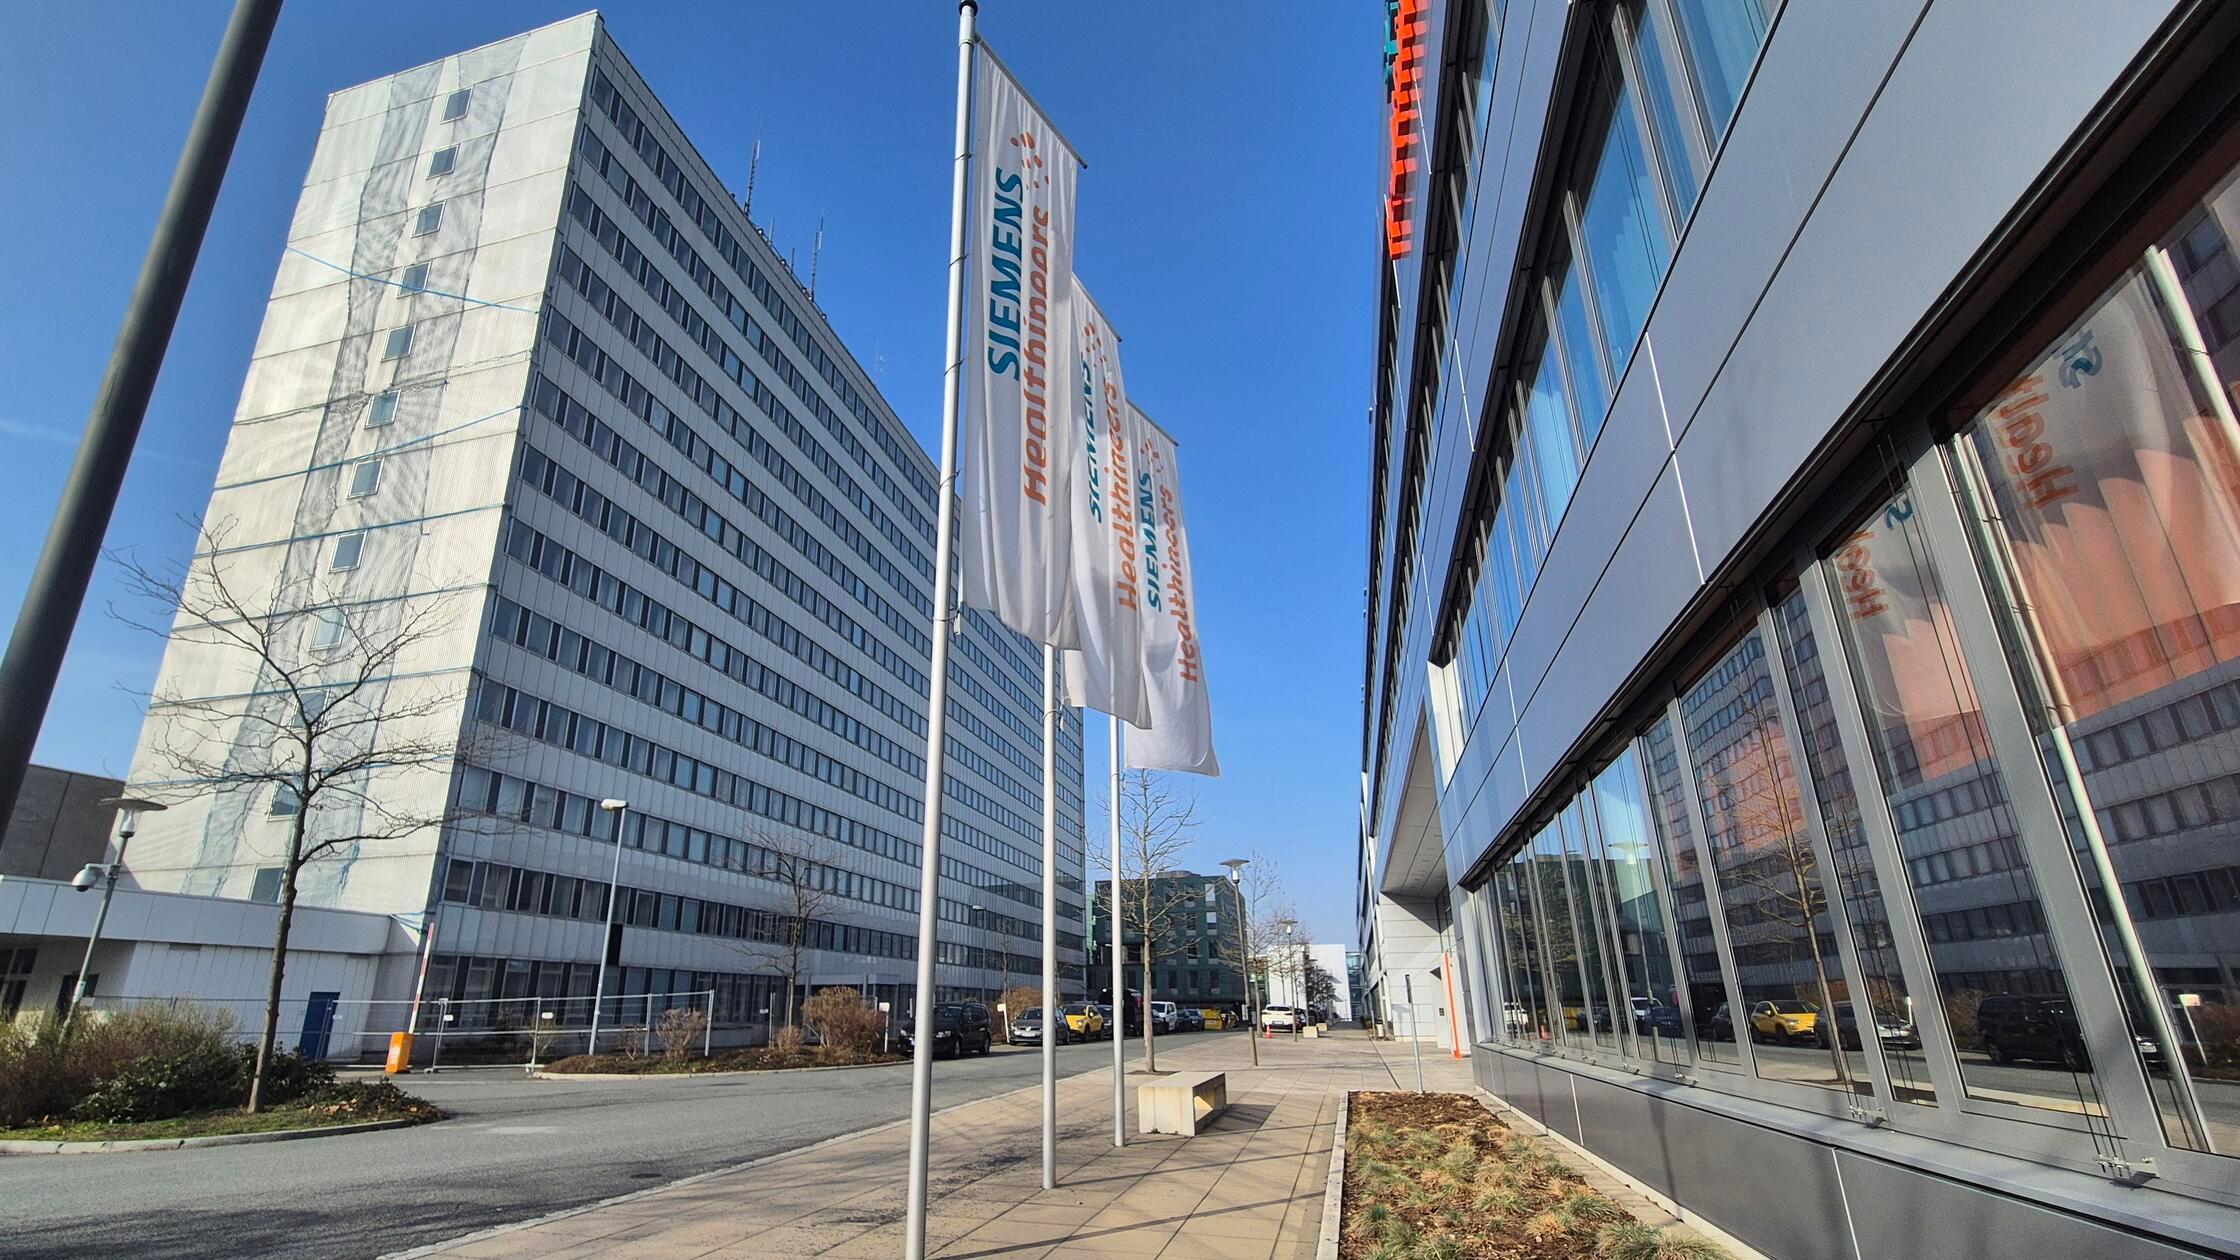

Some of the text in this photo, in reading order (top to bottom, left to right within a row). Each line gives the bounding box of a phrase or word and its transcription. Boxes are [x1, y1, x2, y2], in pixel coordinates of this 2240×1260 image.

[988, 166, 1024, 382] SIEMENS
[1023, 204, 1050, 507] Healthineers
[1103, 376, 1138, 612] Healthineers
[1137, 469, 1162, 613] SIEMENS
